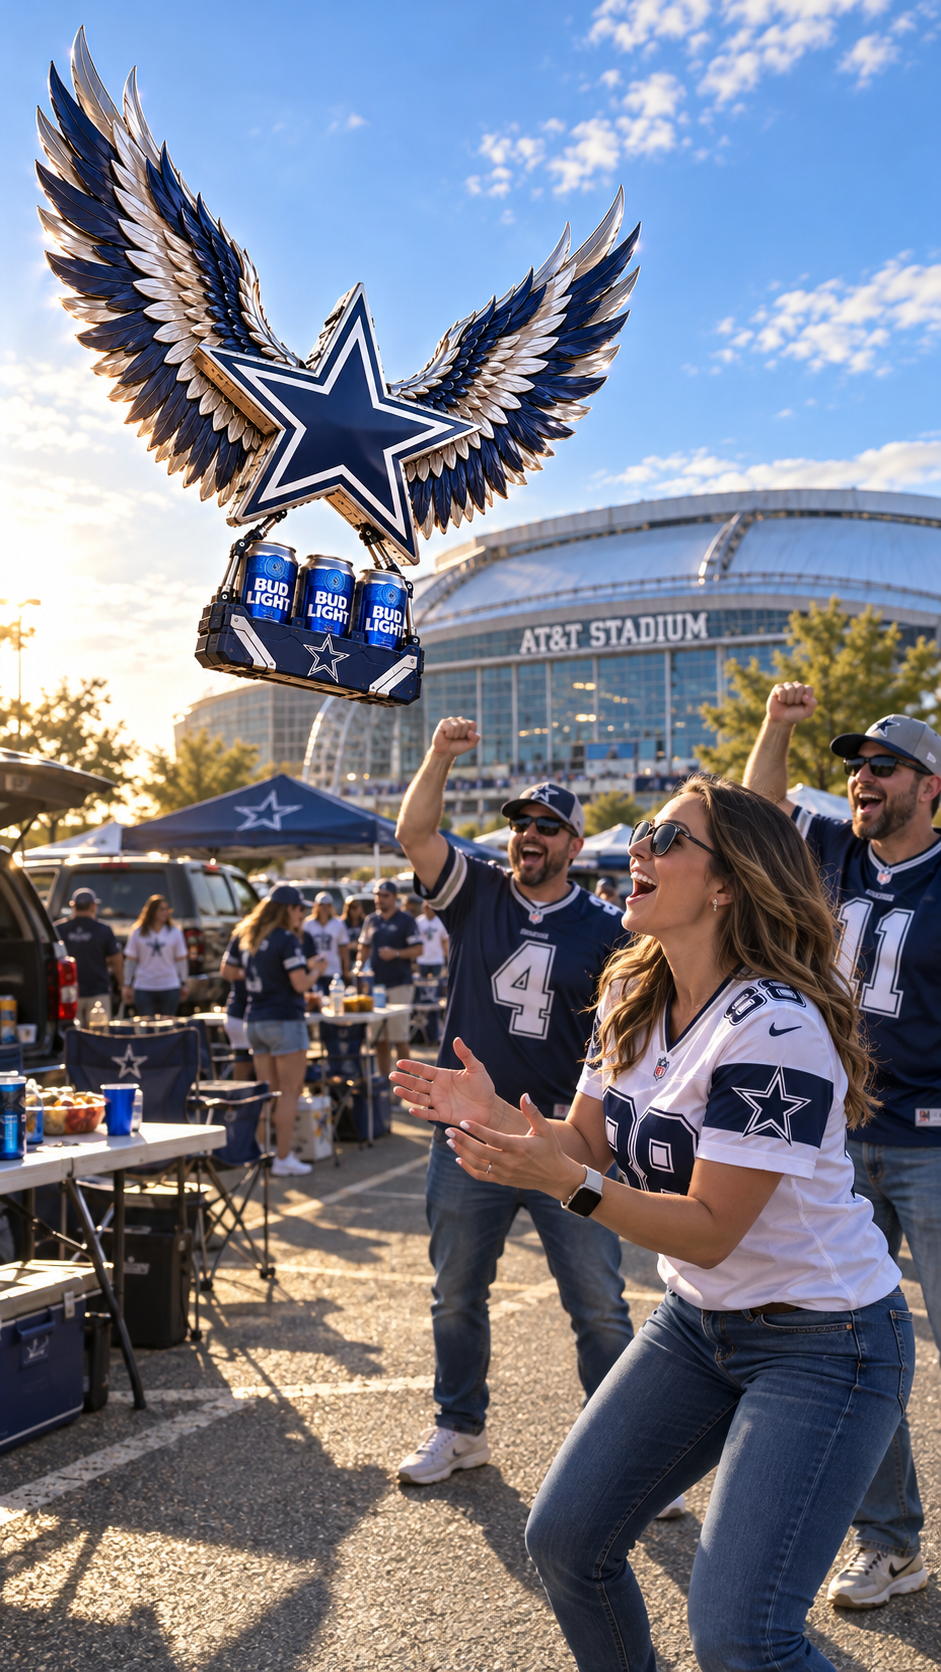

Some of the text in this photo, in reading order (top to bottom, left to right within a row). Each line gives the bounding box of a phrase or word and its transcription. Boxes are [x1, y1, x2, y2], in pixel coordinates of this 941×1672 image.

[254, 577, 289, 597] BUD
[246, 590, 290, 612] LIGHT
[315, 590, 348, 610] BUD
[307, 603, 349, 625] LIGHT
[372, 605, 402, 624] BUD
[365, 617, 403, 638] LIGHT
[519, 611, 709, 655] AT&T STADIUM
[833, 897, 915, 1019] 11
[491, 939, 557, 1041] 4
[724, 979, 807, 1027] 88
